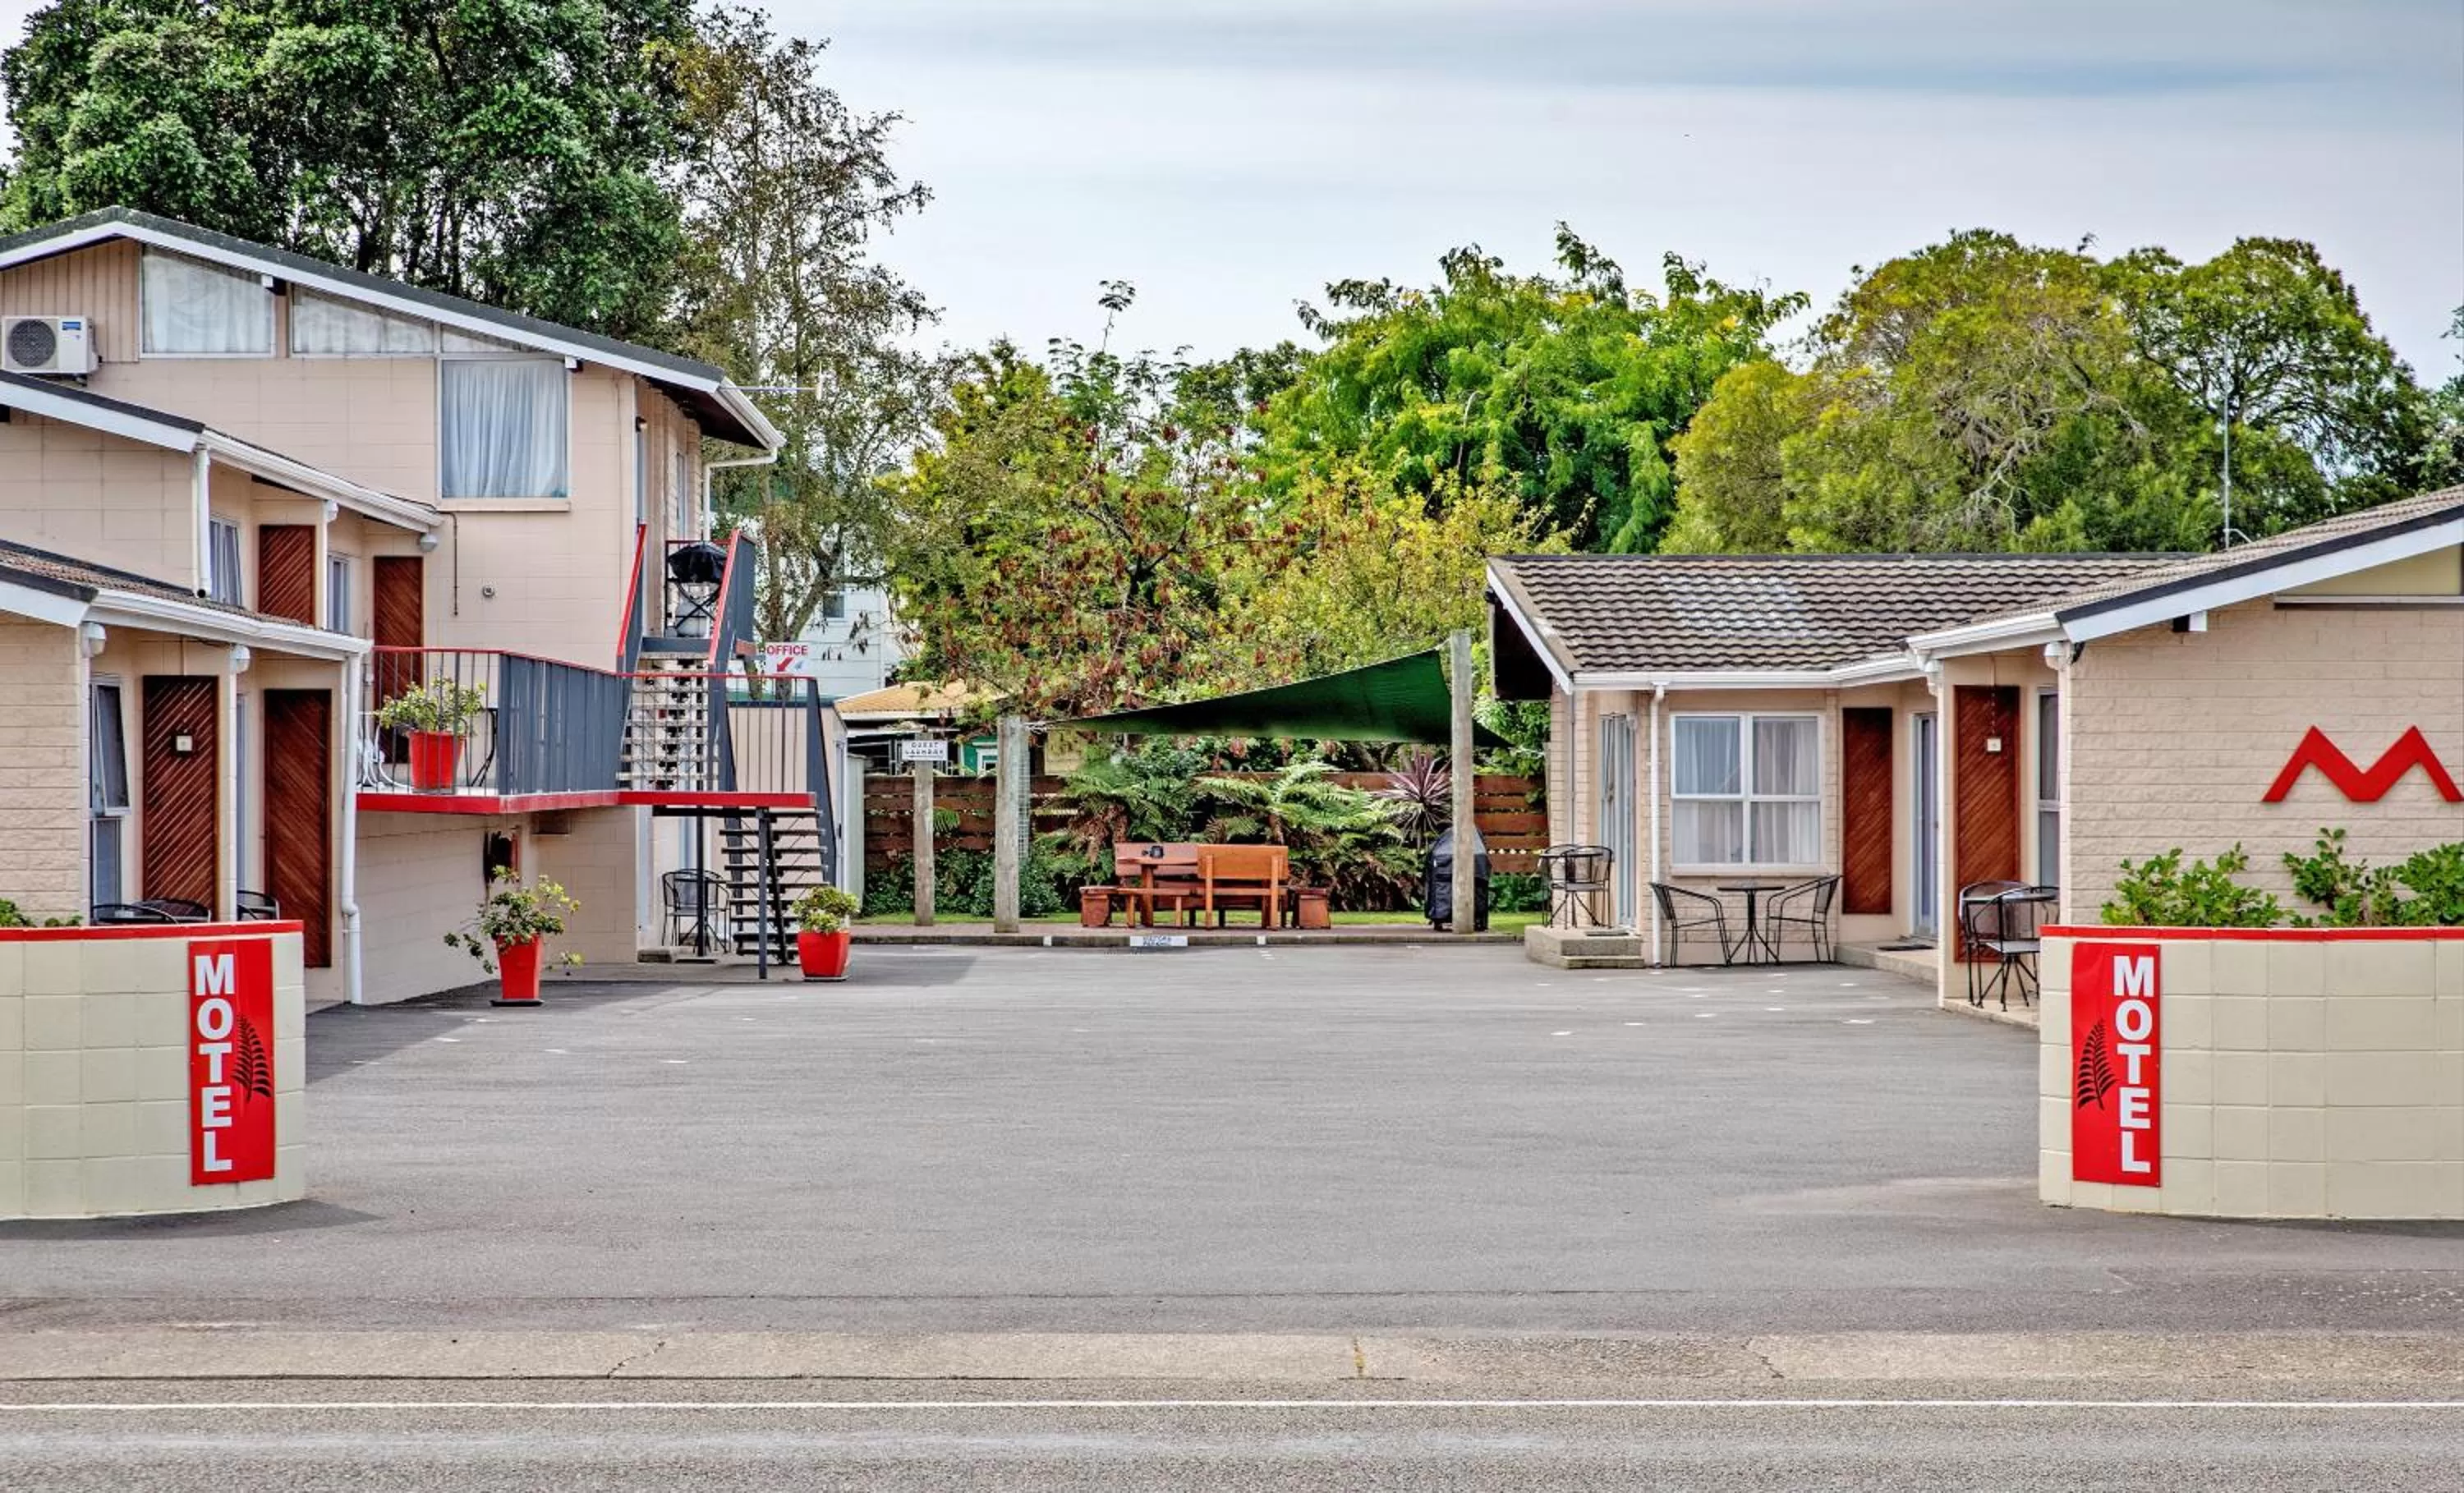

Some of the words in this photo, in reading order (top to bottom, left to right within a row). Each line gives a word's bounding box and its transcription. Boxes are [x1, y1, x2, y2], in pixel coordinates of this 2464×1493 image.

[766, 645, 808, 655] OFFICE
[195, 953, 235, 1172] MOTEL
[2113, 955, 2154, 1174] MOTEL
